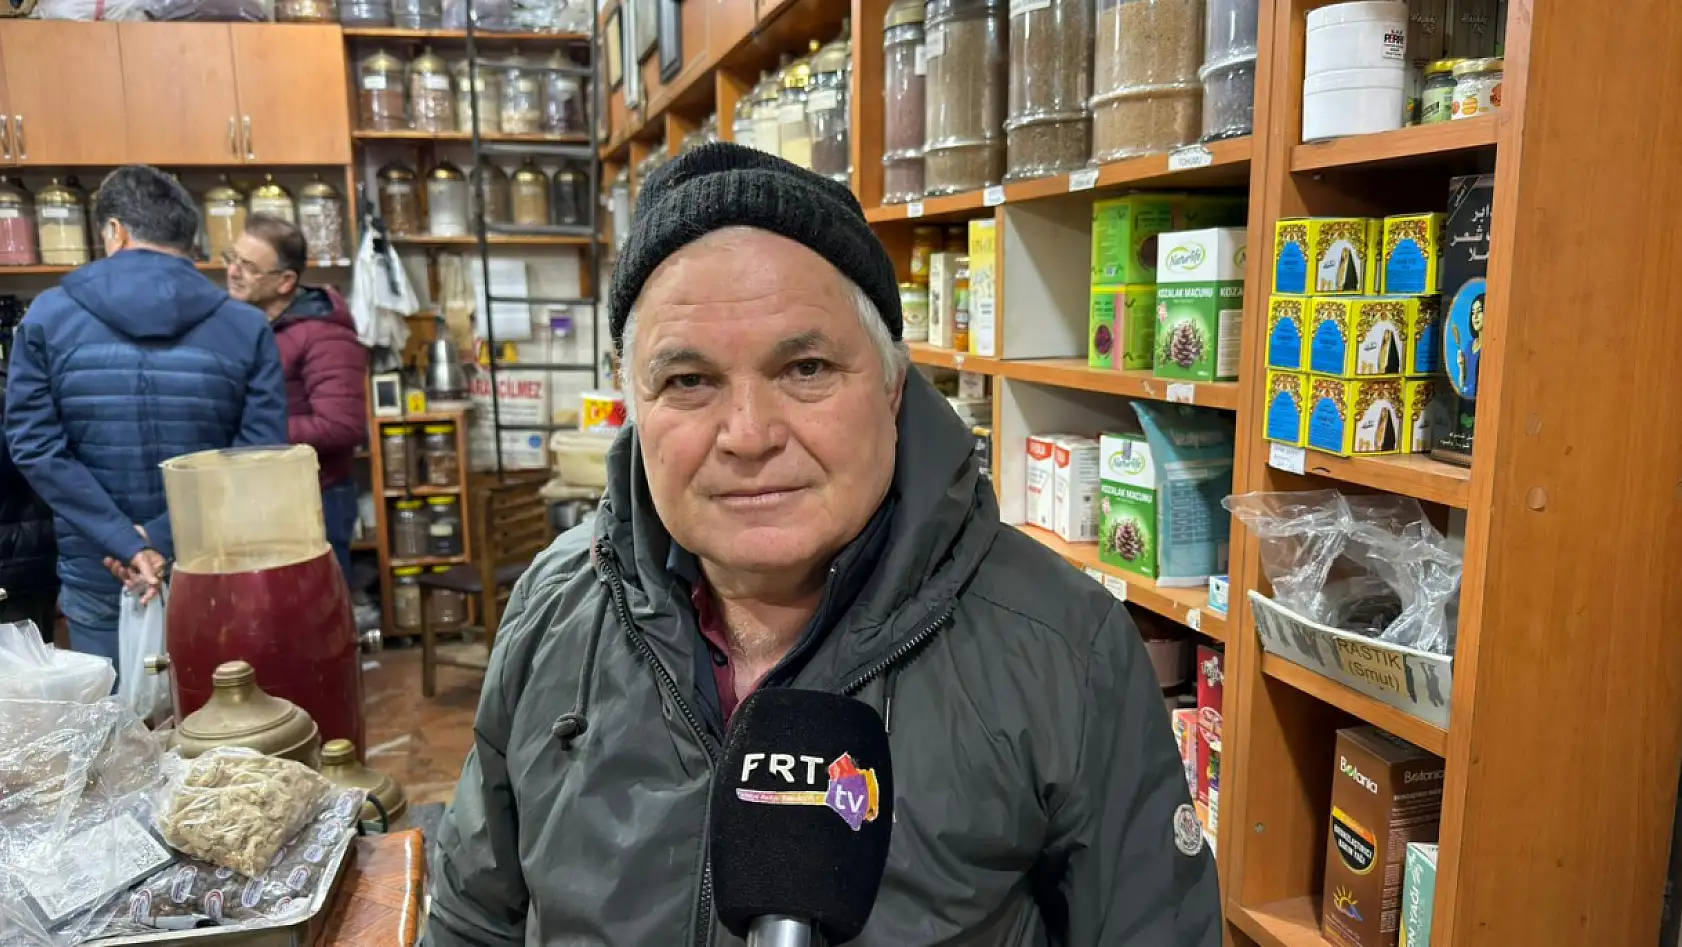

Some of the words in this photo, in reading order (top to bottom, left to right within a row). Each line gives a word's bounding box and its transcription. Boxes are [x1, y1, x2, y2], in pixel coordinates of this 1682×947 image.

[1158, 287, 1184, 298] KOZALAK
[1185, 287, 1214, 298] MACUNU
[1101, 484, 1126, 497] KOZALAK
[1127, 489, 1153, 504] MACUNU
[1336, 637, 1402, 670] RASTIK
[1348, 659, 1400, 692] (Smut)
[740, 753, 825, 785] FRT
[1340, 754, 1378, 795] Botania
[834, 784, 866, 814] tv
